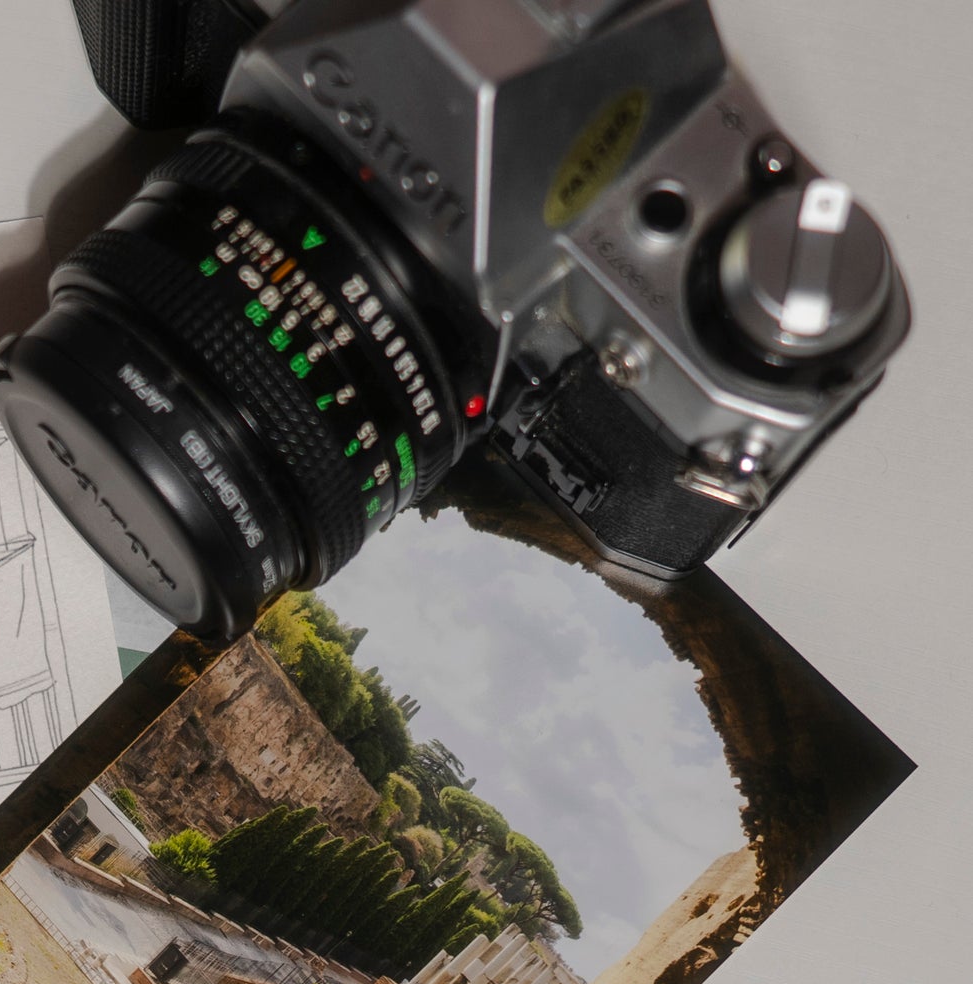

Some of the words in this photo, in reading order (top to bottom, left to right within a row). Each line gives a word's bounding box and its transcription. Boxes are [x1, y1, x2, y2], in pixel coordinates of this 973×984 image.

[302, 48, 468, 237] Canon
[301, 225, 326, 250] A
[117, 363, 174, 414] JAPAN
[244, 299, 272, 327] 30
[267, 326, 293, 352] 15
[289, 352, 314, 379] 10
[316, 393, 335, 411] 7
[344, 438, 361, 457] 5
[258, 285, 285, 312] 10
[280, 309, 302, 332] 5
[306, 341, 327, 363] 3
[336, 384, 356, 405] 2
[341, 273, 370, 304] 22
[357, 295, 383, 323] 16
[371, 314, 396, 341] 11
[385, 336, 407, 358] 8
[406, 373, 425, 394] 4
[37, 421, 177, 590] Canon
[202, 463, 264, 549] SKYLIGHT
[394, 431, 417, 490] 50mm
